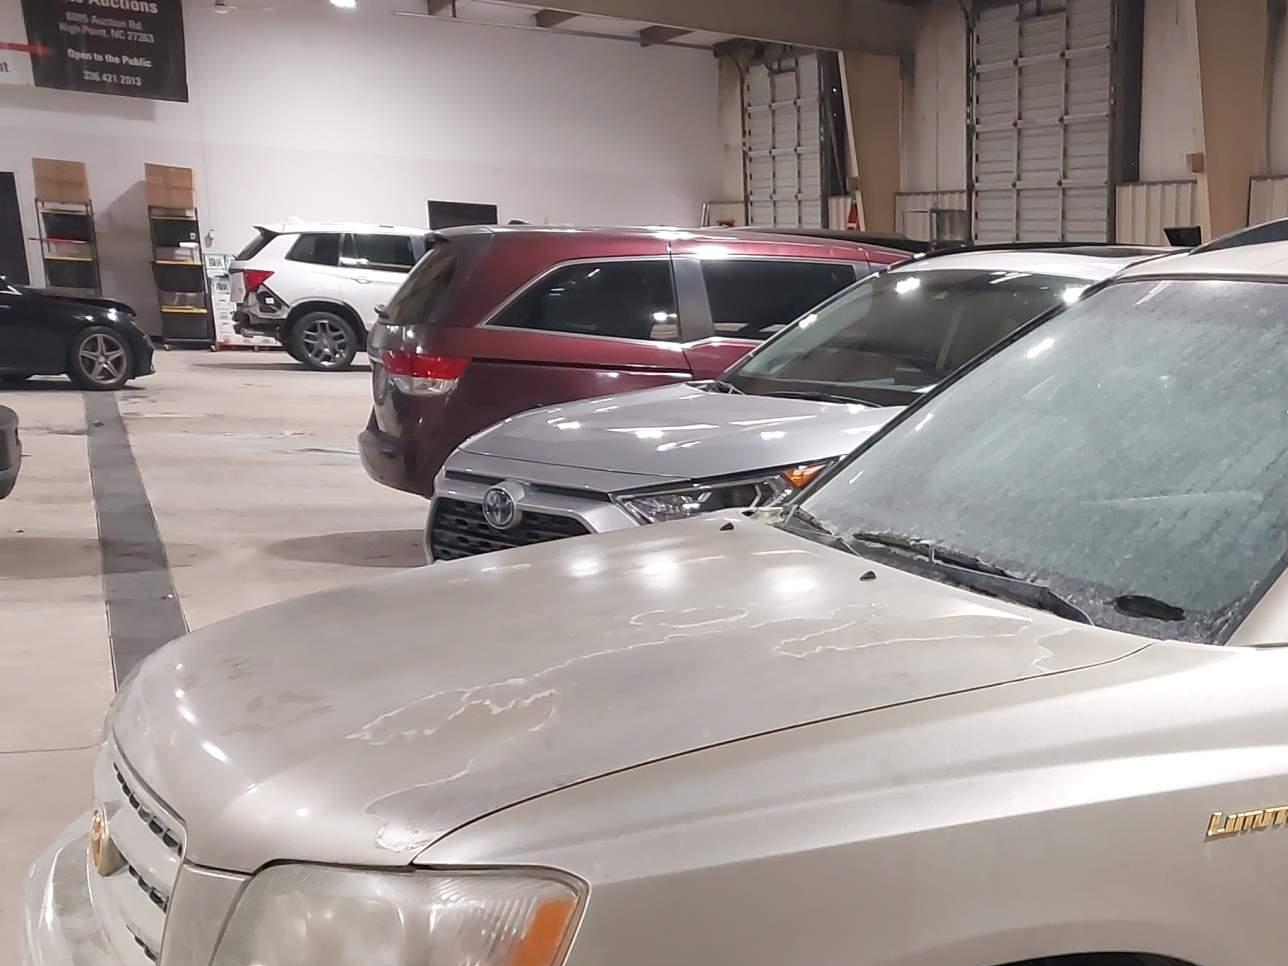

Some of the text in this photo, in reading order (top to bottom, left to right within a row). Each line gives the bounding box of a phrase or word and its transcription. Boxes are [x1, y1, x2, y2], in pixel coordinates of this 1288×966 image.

[59, 22, 81, 35] High
[111, 29, 125, 40] NC
[67, 49, 152, 67] Open to the Public
